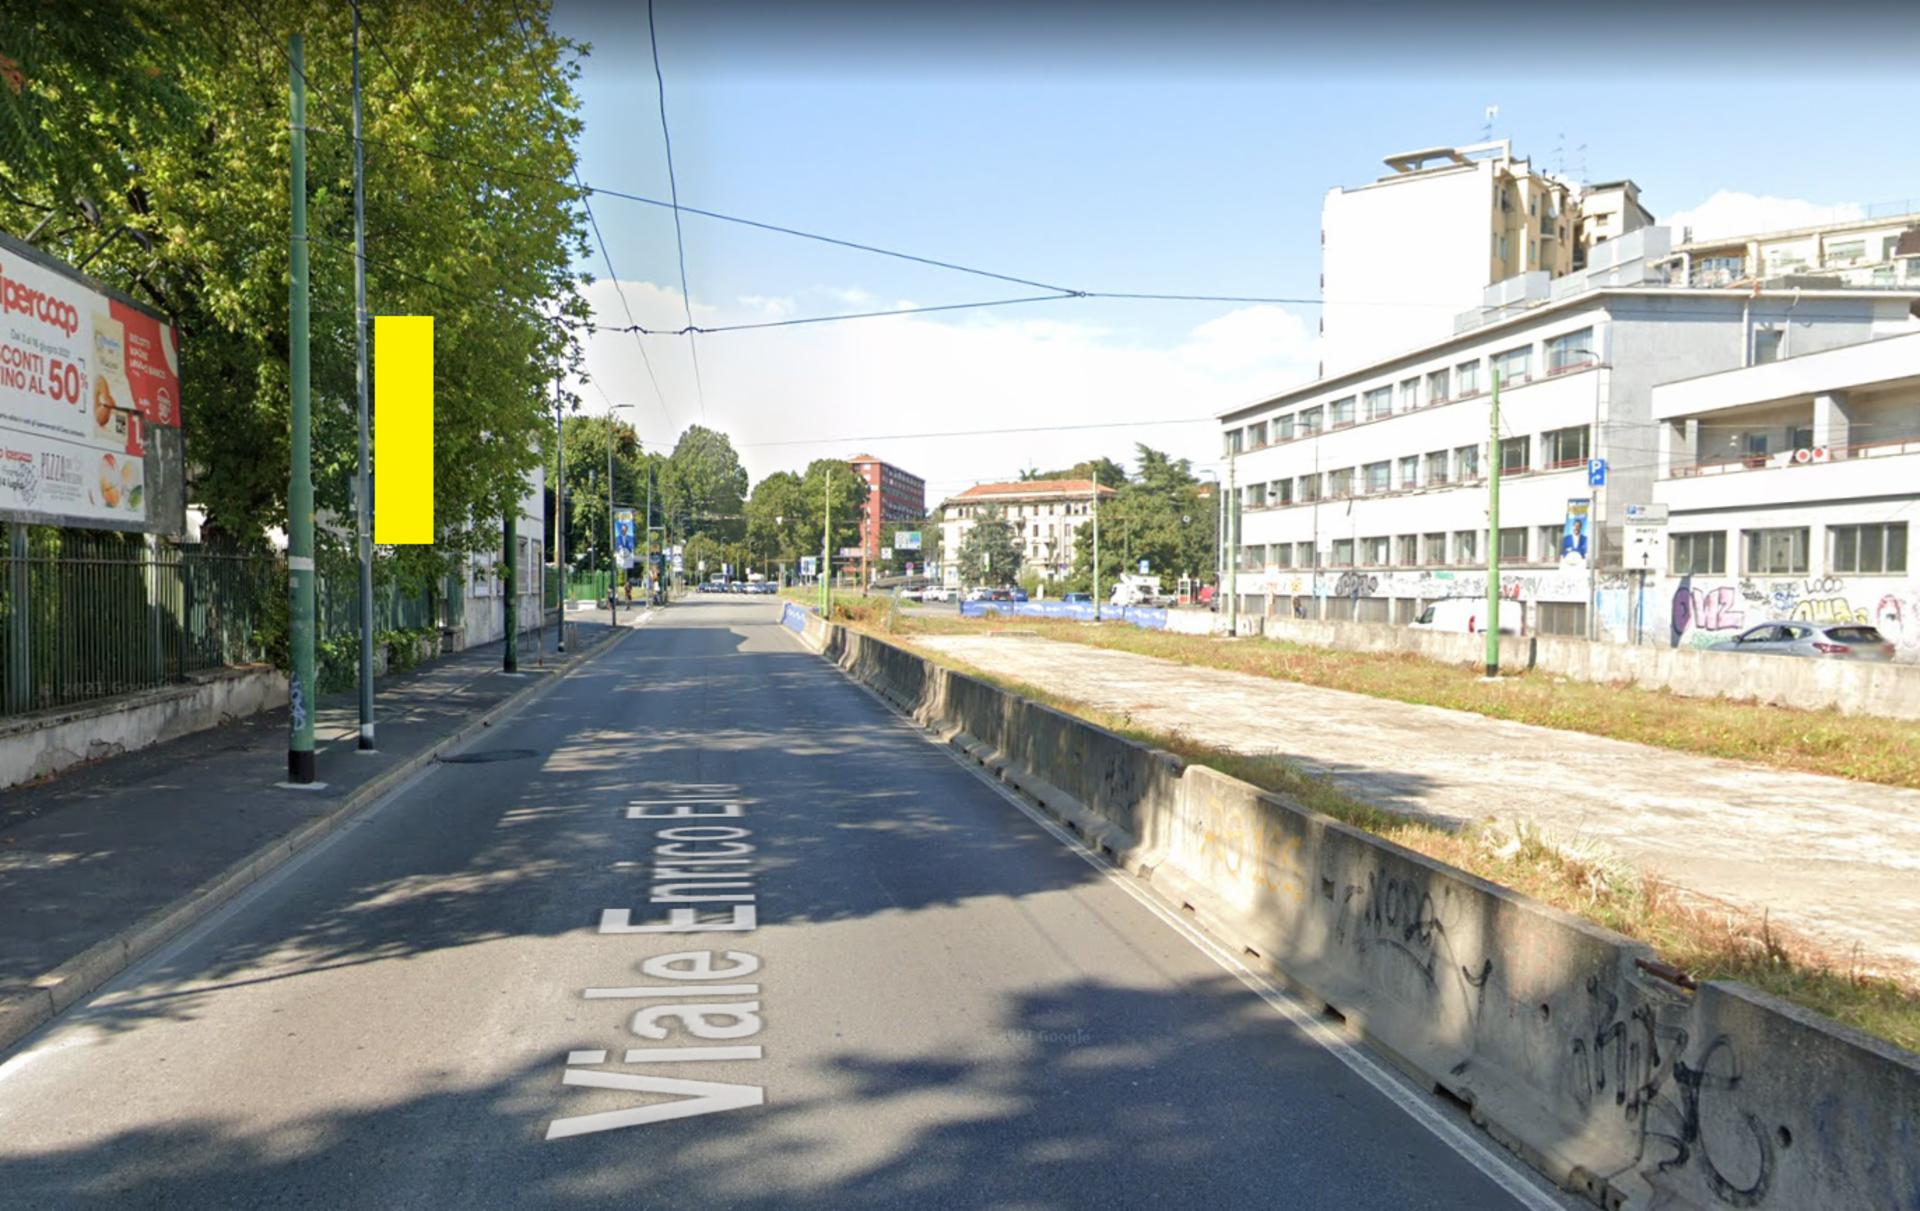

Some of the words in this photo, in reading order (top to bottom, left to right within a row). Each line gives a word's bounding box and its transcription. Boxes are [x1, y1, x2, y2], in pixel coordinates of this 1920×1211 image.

[0, 343, 43, 376] CONTI
[0, 365, 26, 390] INO
[28, 374, 46, 395] AL
